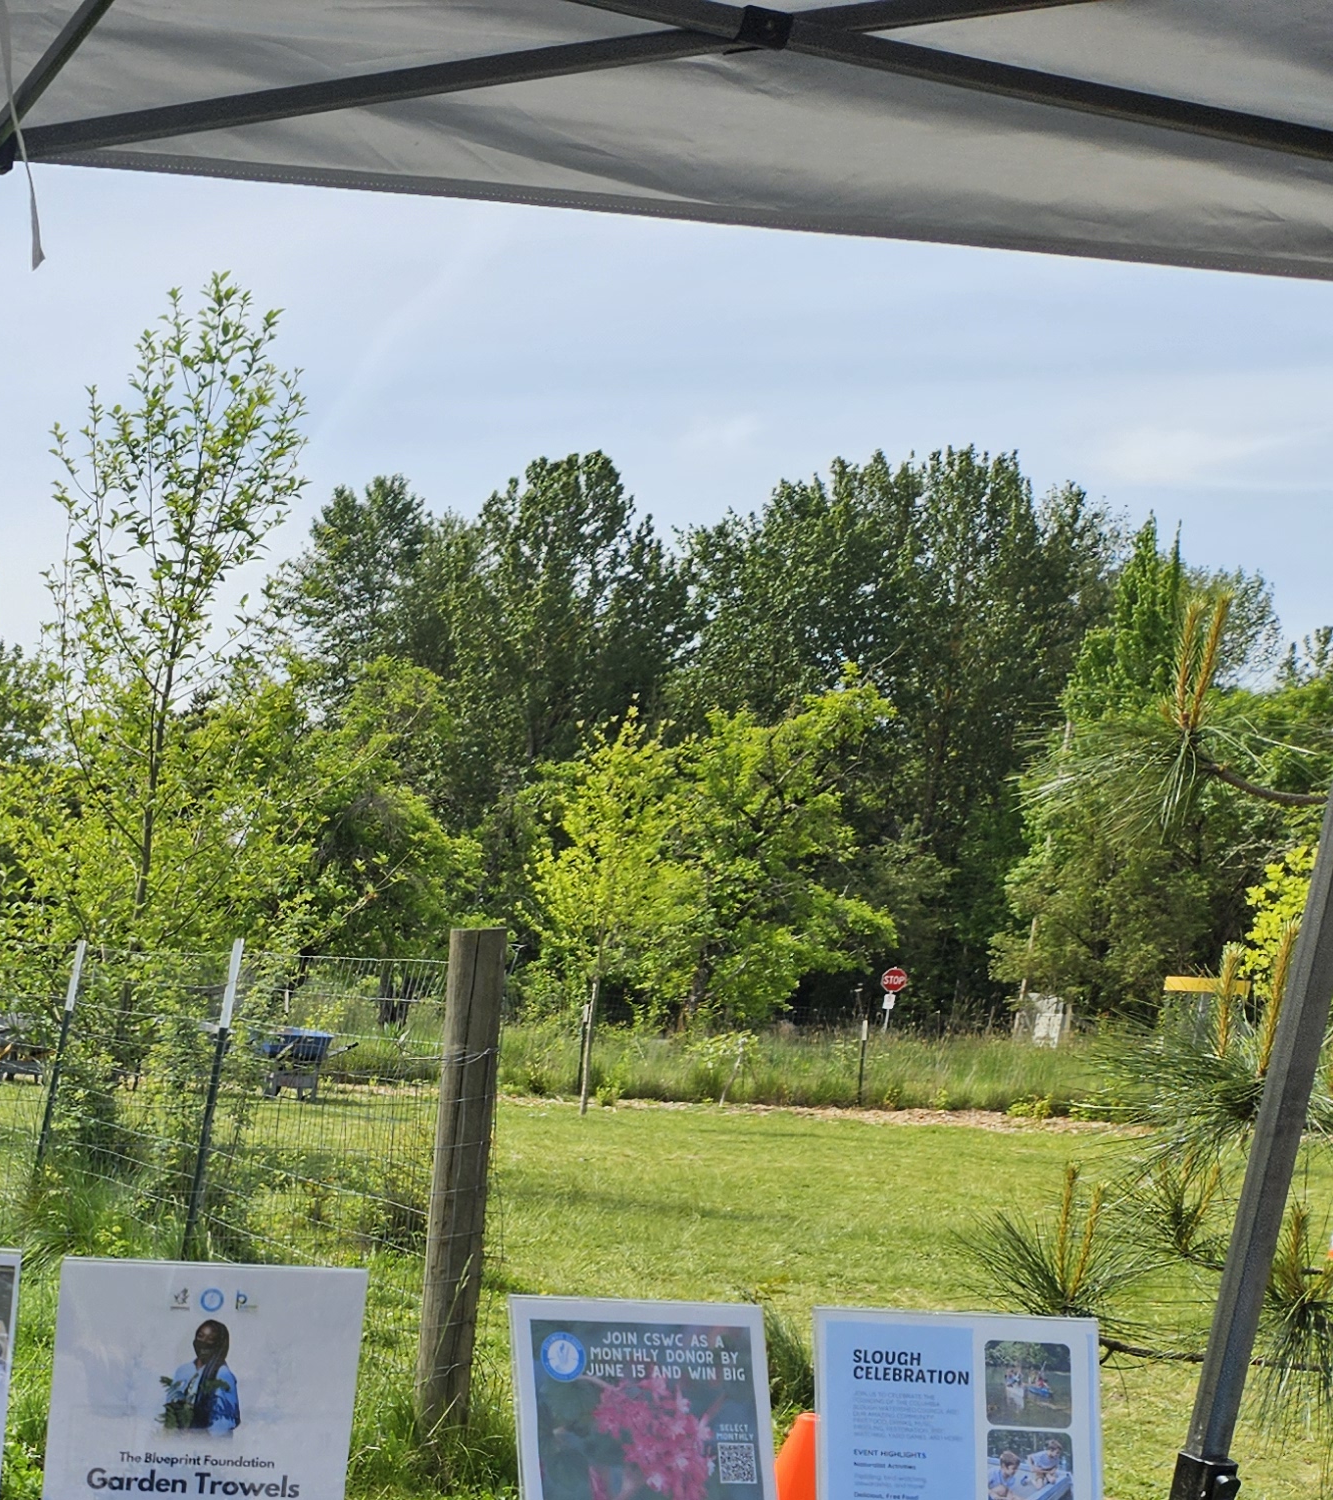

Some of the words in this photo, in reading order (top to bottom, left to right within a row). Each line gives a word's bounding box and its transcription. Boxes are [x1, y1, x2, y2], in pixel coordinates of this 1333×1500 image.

[883, 975, 905, 985] STOP
[602, 1331, 637, 1345] JOIN
[644, 1332, 683, 1347] CSWC
[691, 1334, 708, 1348] AS
[715, 1335, 725, 1349] A
[590, 1347, 658, 1363] MONTHLY
[666, 1350, 714, 1364] DONOR
[721, 1351, 739, 1365] BY
[853, 1348, 921, 1366] SLOUGH
[586, 1363, 624, 1377] JUNE
[632, 1364, 645, 1378] 15
[653, 1365, 682, 1379] AND
[688, 1366, 717, 1380] WIN
[723, 1367, 746, 1382] BIG
[853, 1365, 969, 1385] CELEBRATION
[716, 1432, 754, 1441] MONTHLY
[719, 1424, 749, 1432] SELECT
[119, 1451, 142, 1464] The
[144, 1453, 202, 1468] Blueprint
[204, 1455, 275, 1469] Foundation
[881, 1449, 927, 1459] HIGHLIGHTS
[87, 1467, 187, 1494] Garden
[195, 1472, 300, 1498] Trowels
